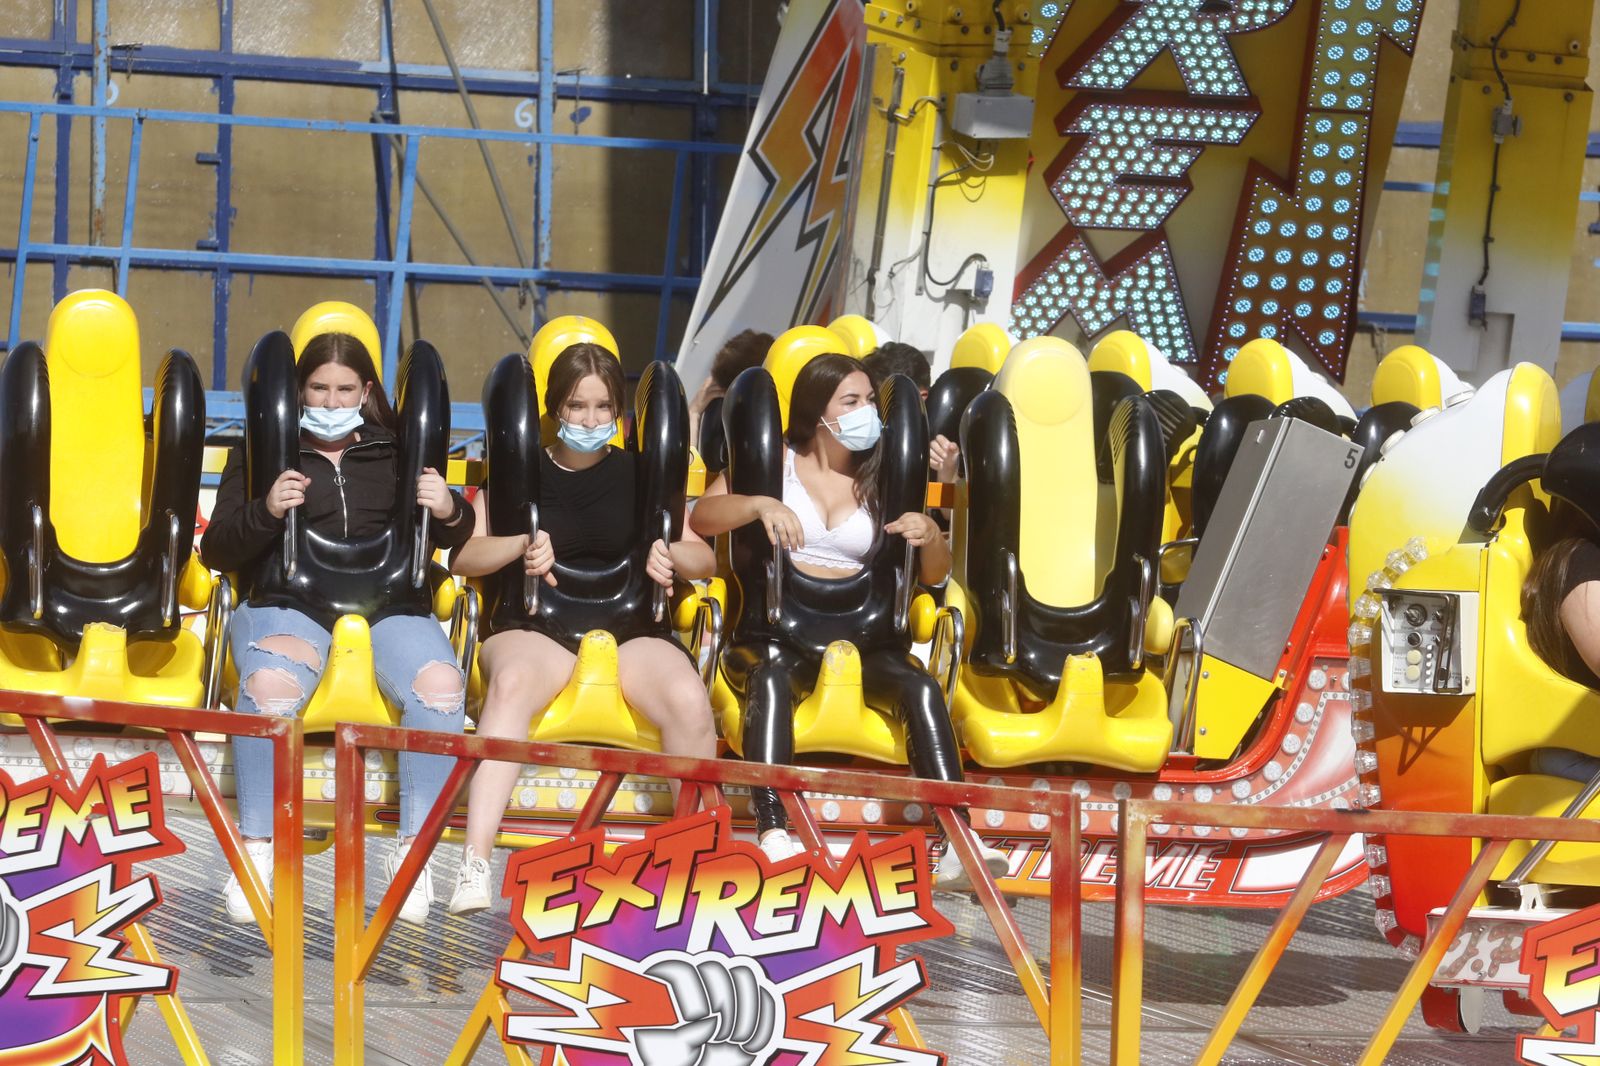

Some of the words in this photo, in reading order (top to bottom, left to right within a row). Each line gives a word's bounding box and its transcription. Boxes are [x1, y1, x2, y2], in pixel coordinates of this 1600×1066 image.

[514, 98, 534, 128] 6
[1344, 448, 1359, 469] 5
[0, 767, 162, 875] EME
